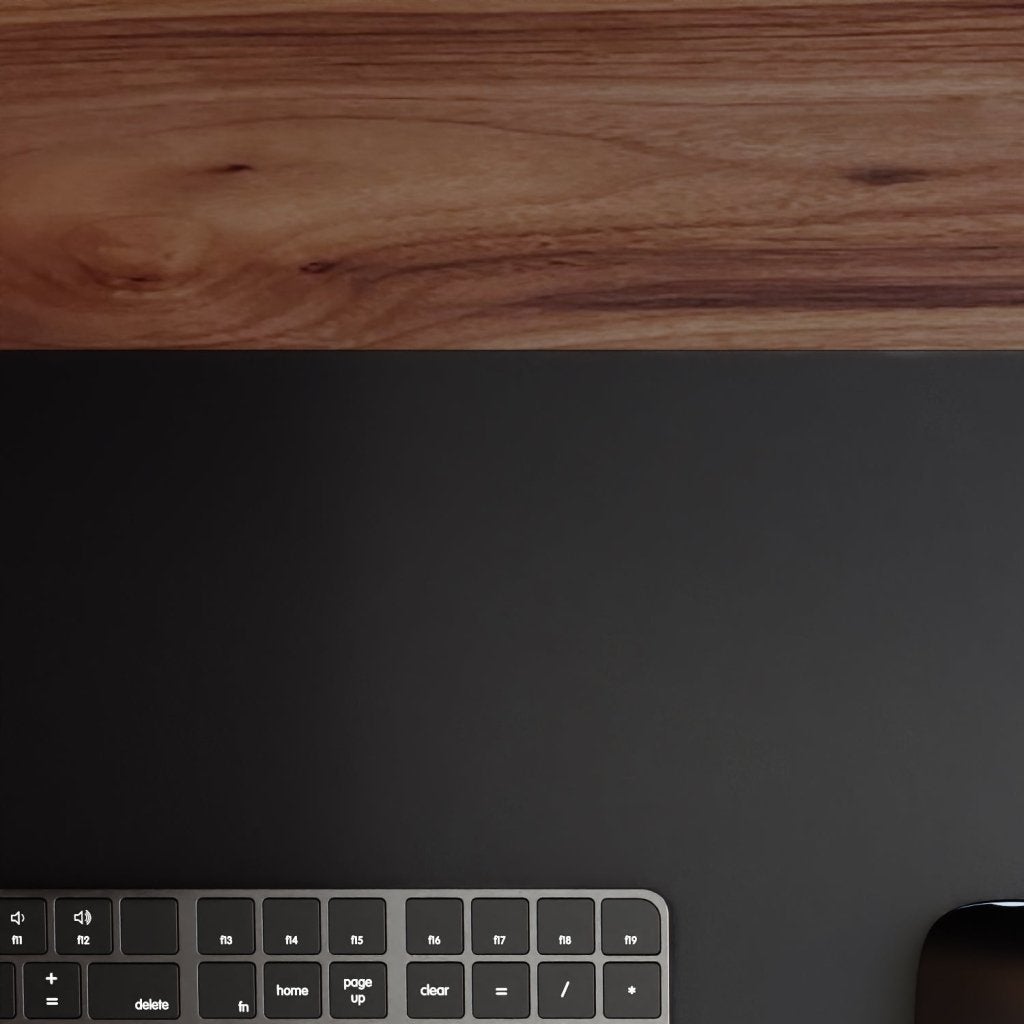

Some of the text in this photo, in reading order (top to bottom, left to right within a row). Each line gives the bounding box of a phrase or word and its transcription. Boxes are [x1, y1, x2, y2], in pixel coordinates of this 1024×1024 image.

[76, 934, 91, 946] f12
[219, 934, 233, 946] f13
[284, 934, 299, 945] f14
[350, 934, 364, 946] f15
[427, 934, 442, 946] f16
[493, 934, 507, 945] f17
[558, 934, 572, 946] f18
[623, 934, 638, 945] f19
[45, 972, 58, 985] +
[343, 978, 373, 991] page
[276, 983, 309, 997] home
[419, 983, 450, 997] clear
[495, 987, 508, 996] =
[560, 980, 570, 998] /
[45, 997, 59, 1006] =
[134, 998, 170, 1011] delete
[350, 993, 366, 1006] up
[237, 1000, 250, 1013] fn
